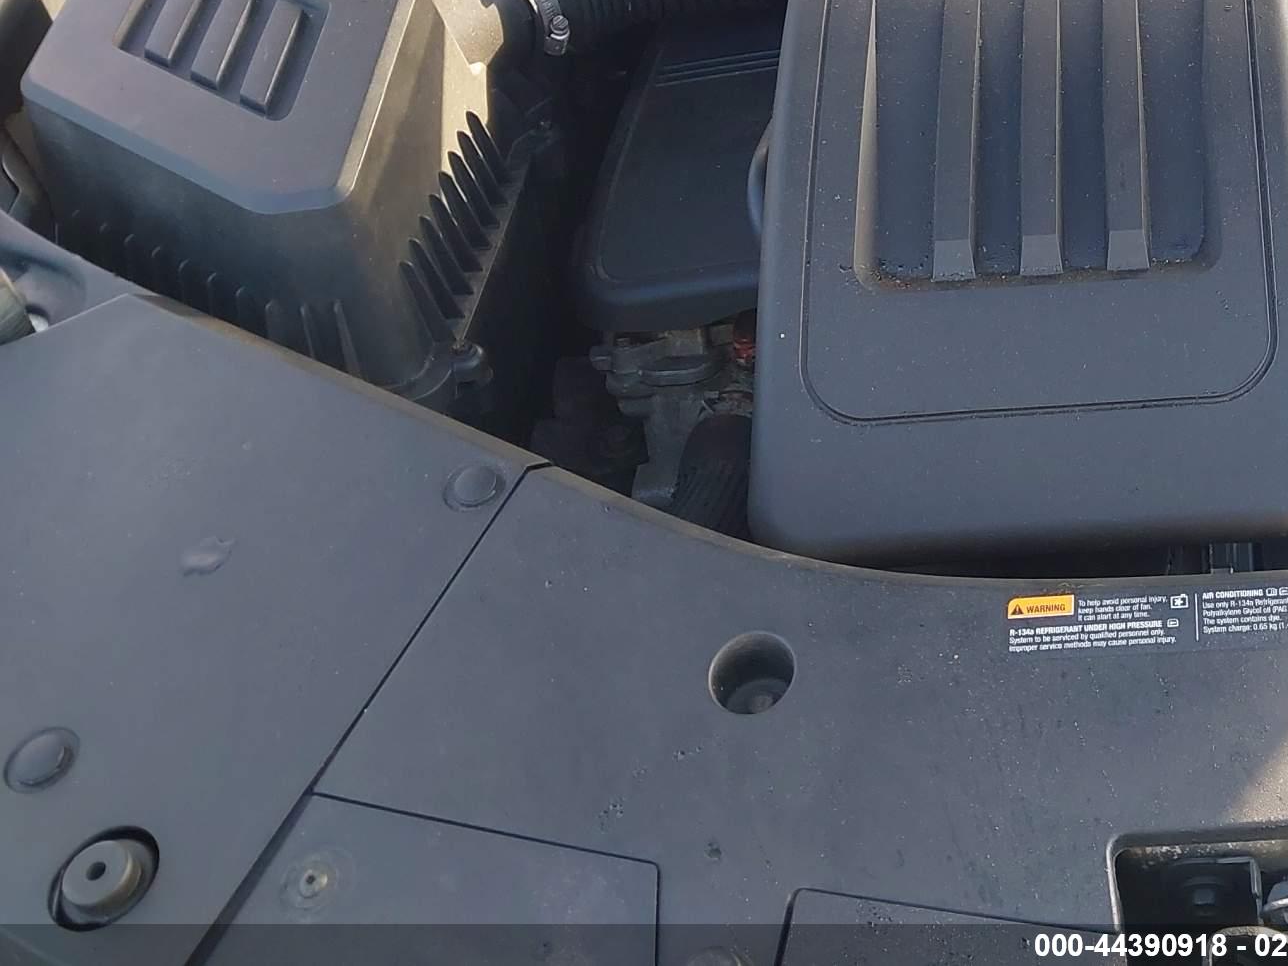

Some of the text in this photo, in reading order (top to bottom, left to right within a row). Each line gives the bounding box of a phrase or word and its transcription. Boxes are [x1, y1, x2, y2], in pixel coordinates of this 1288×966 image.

[1215, 589, 1263, 599] CONDITIONING
[1087, 599, 1101, 607] help
[1102, 598, 1119, 606] avoid
[1120, 596, 1147, 605] personal
[1202, 601, 1214, 609] Use
[1215, 600, 1228, 609] only
[1230, 599, 1253, 607] R-134a
[1254, 597, 1288, 607] Refrigerant
[1026, 603, 1066, 614] WARNING
[1078, 606, 1094, 615] keep
[1203, 608, 1241, 618] Polyalkylene
[1243, 607, 1262, 615] Glycol
[1272, 605, 1287, 614] (PAG
[1121, 612, 1133, 620] any
[1203, 614, 1282, 625] The system contains dye.
[1009, 620, 1163, 637] R-134a REFRIGERANT UNDER HIGH PRESSURE
[1203, 625, 1227, 634] System
[1228, 623, 1252, 632] charge:
[1253, 622, 1268, 630] 0.65
[1269, 622, 1278, 631] kg
[1009, 636, 1033, 645] System
[1052, 633, 1079, 642] serviced
[1080, 633, 1088, 641] by
[1089, 631, 1116, 640] qualified
[1118, 629, 1149, 639] personnel
[1150, 628, 1165, 636] only.
[1009, 635, 1176, 653] Improper service methods may cause personal injury.
